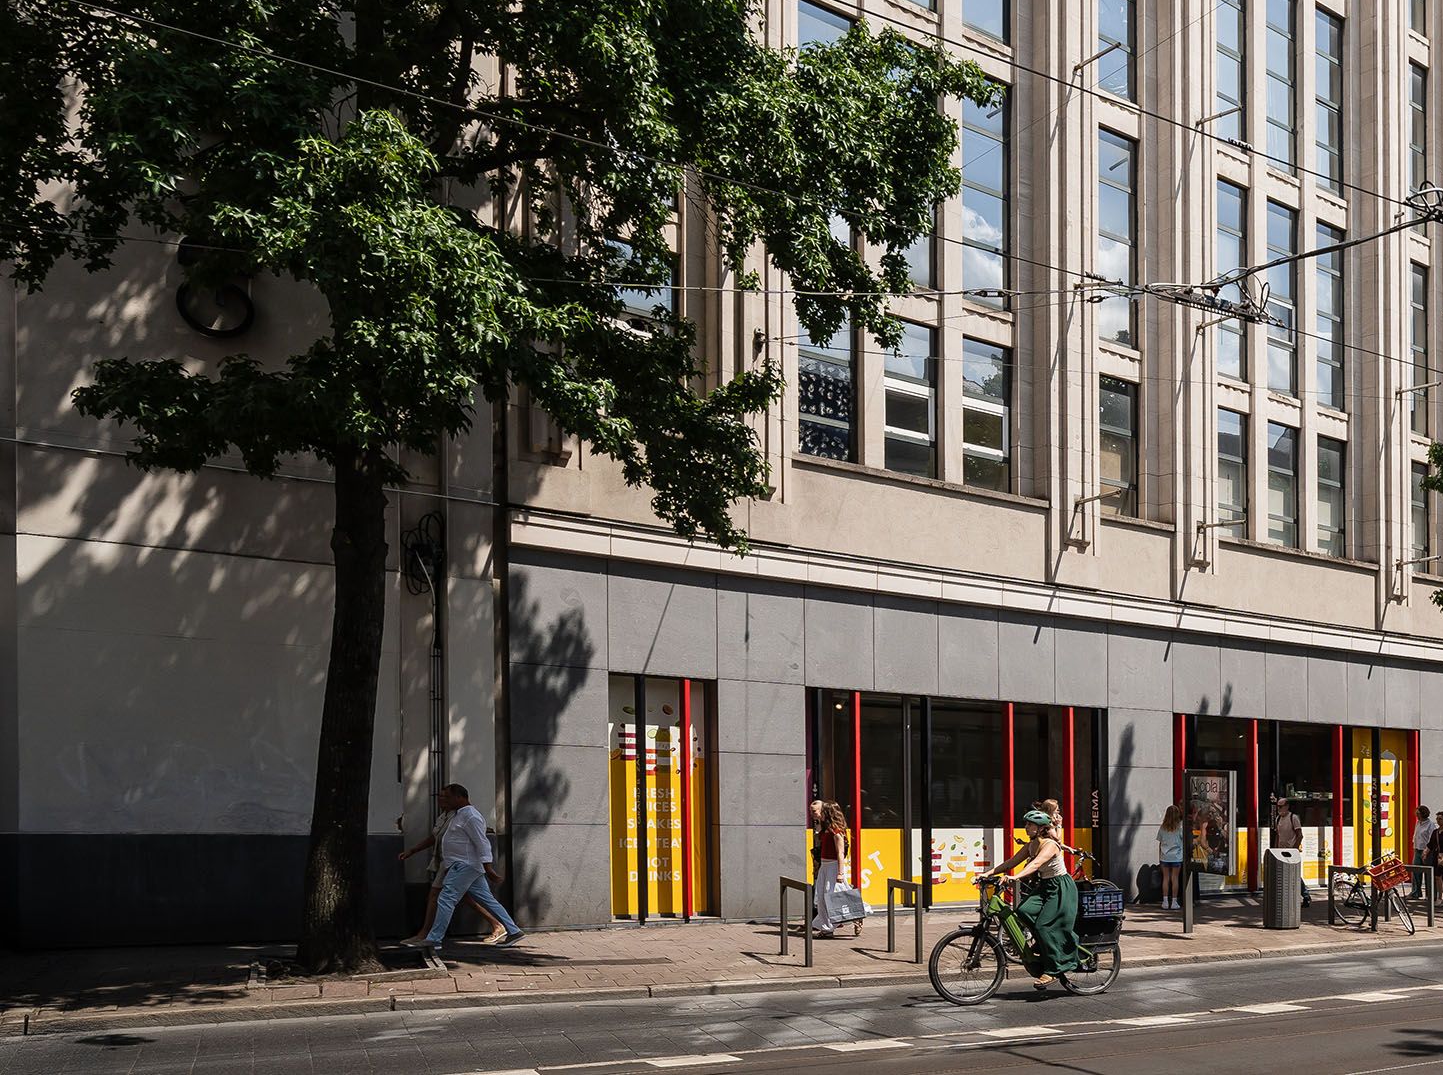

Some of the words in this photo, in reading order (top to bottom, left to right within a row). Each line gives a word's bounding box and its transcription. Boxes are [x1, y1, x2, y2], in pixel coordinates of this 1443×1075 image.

[632, 801, 677, 812] JICES
[1091, 789, 1099, 828] HEMA
[627, 818, 681, 829] SAKES
[629, 870, 681, 882] DINKS
